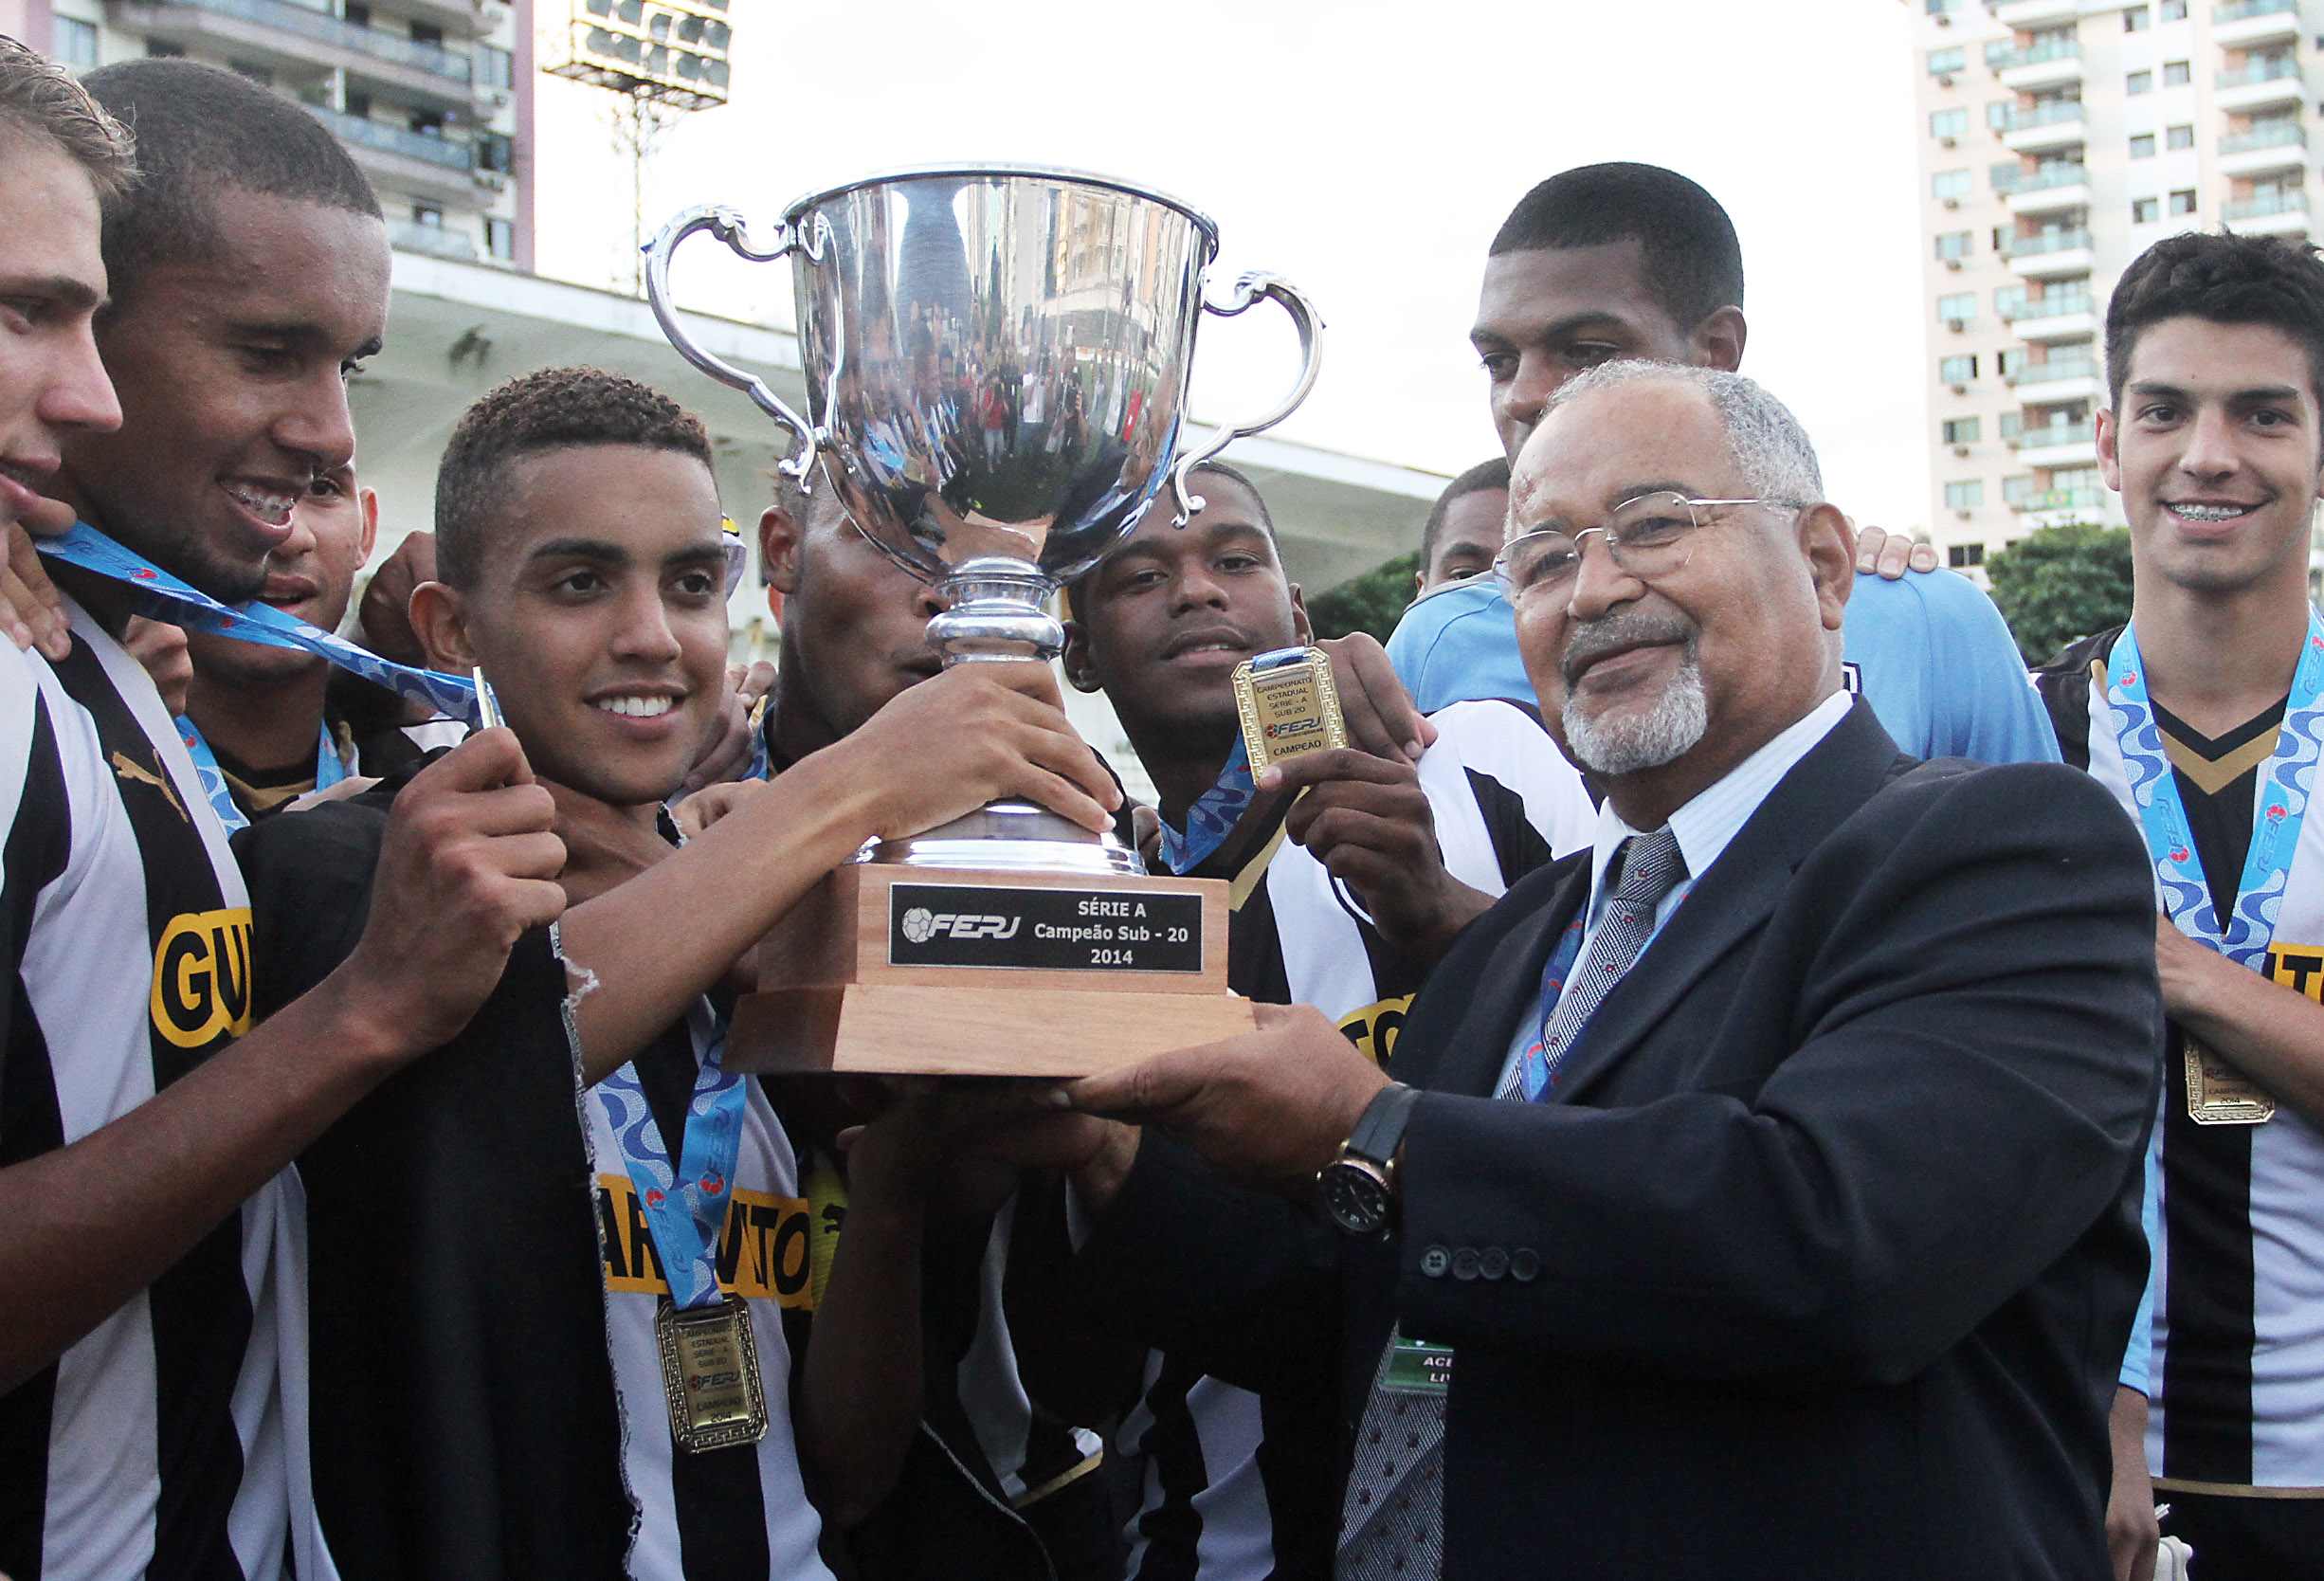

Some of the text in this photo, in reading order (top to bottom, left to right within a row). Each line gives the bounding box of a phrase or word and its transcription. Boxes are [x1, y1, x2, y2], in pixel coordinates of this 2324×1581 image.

[1257, 677, 1313, 694] CAMPEONATO
[1266, 687, 1309, 701] ESTADUAL
[1274, 705, 1306, 718] SUB 20
[1278, 717, 1321, 735] FERJ
[1078, 897, 1147, 918] SÉRIE A
[927, 913, 1022, 939] FERJ
[1034, 922, 1114, 942] Campeão
[1117, 925, 1150, 941] Sub
[1167, 927, 1189, 942] 20
[1090, 948, 1134, 965] 2014
[161, 922, 253, 1032] GU
[691, 1336, 730, 1348] ESTADUAL
[699, 1358, 716, 1368] SUB
[700, 1370, 740, 1387] FERJ
[1429, 1372, 1450, 1383] LI
[710, 1411, 732, 1423] 2014
